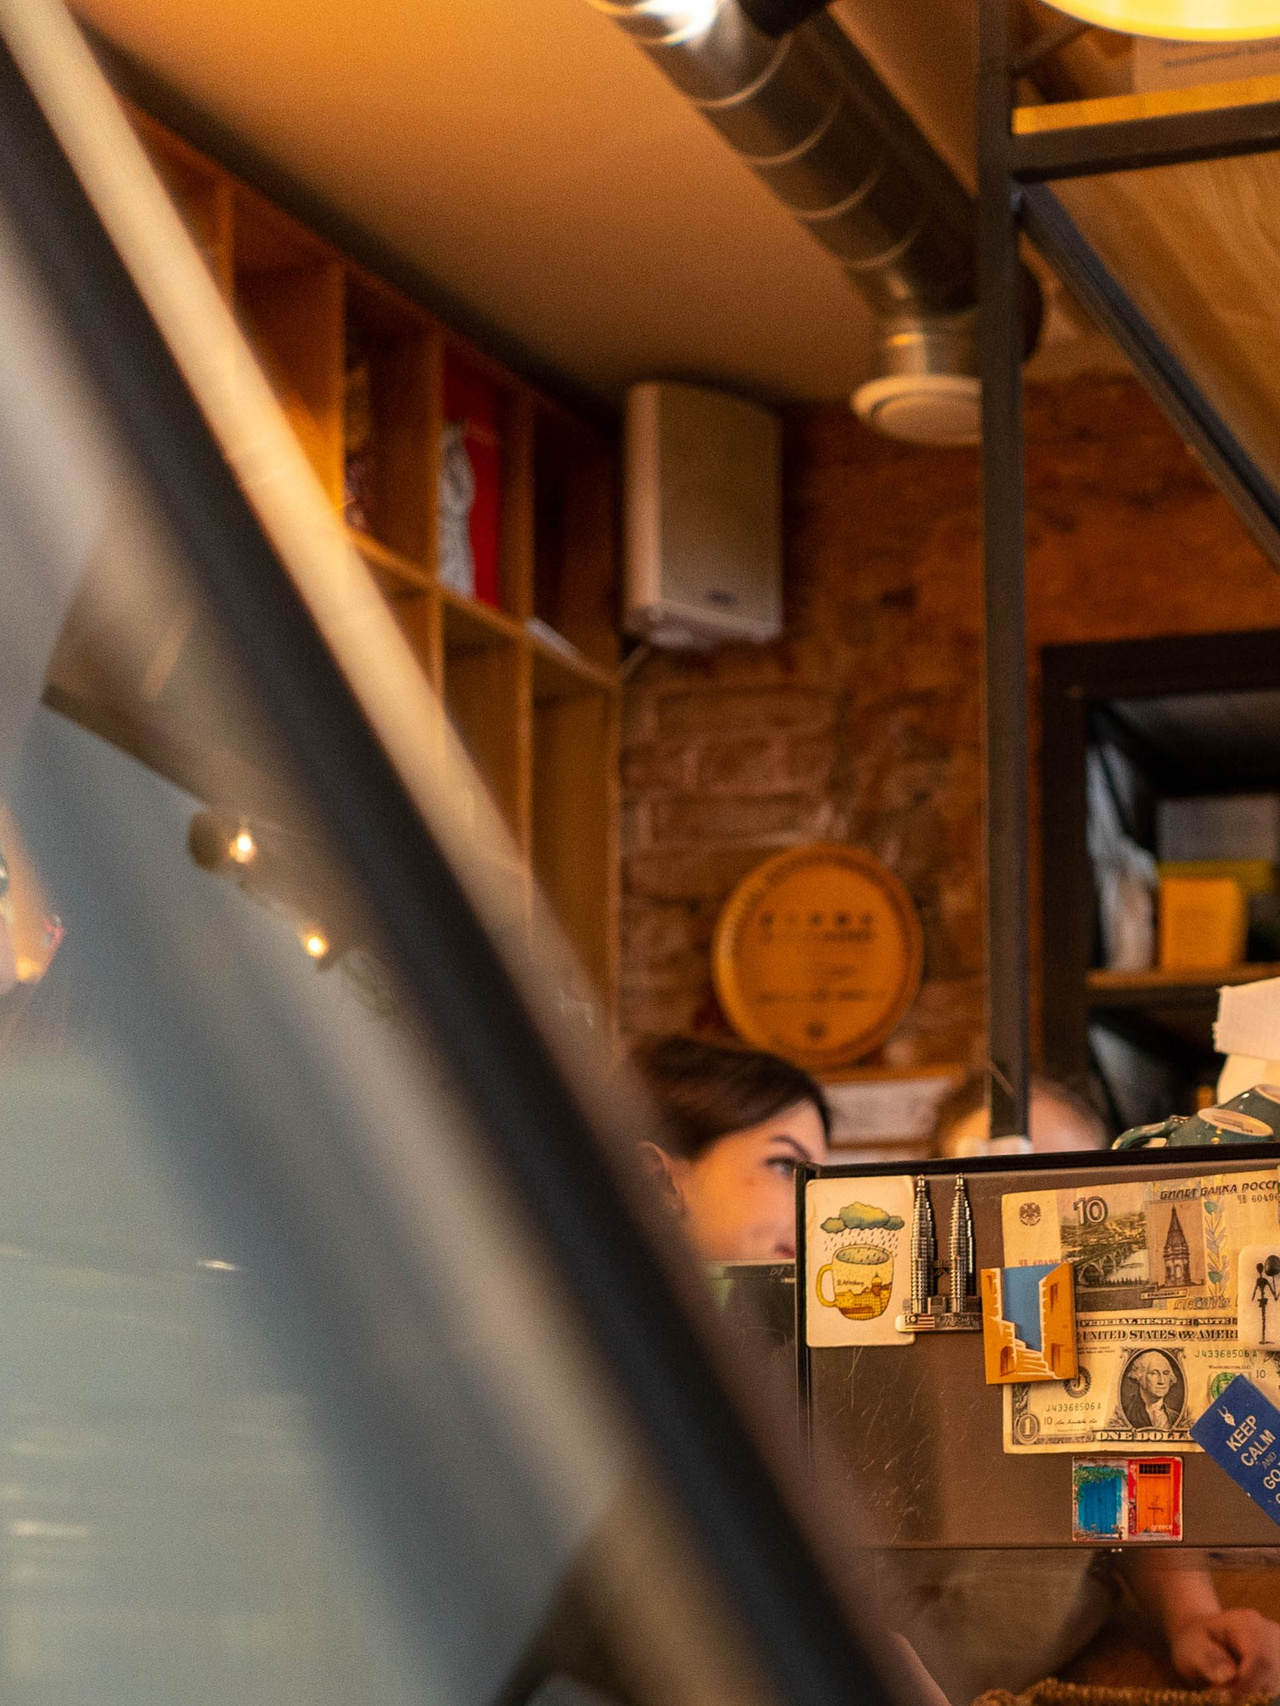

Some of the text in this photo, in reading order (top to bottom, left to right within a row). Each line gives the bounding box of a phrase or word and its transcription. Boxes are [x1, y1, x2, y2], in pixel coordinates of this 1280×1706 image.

[1073, 1196, 1109, 1225] 10
[1082, 1329, 1126, 1341] UNITED
[1128, 1329, 1176, 1340] STATES
[1197, 1329, 1239, 1341] AMERI
[1095, 1431, 1133, 1441] ONE
[1225, 1415, 1257, 1452] KEEP
[1241, 1429, 1276, 1467] CALM
